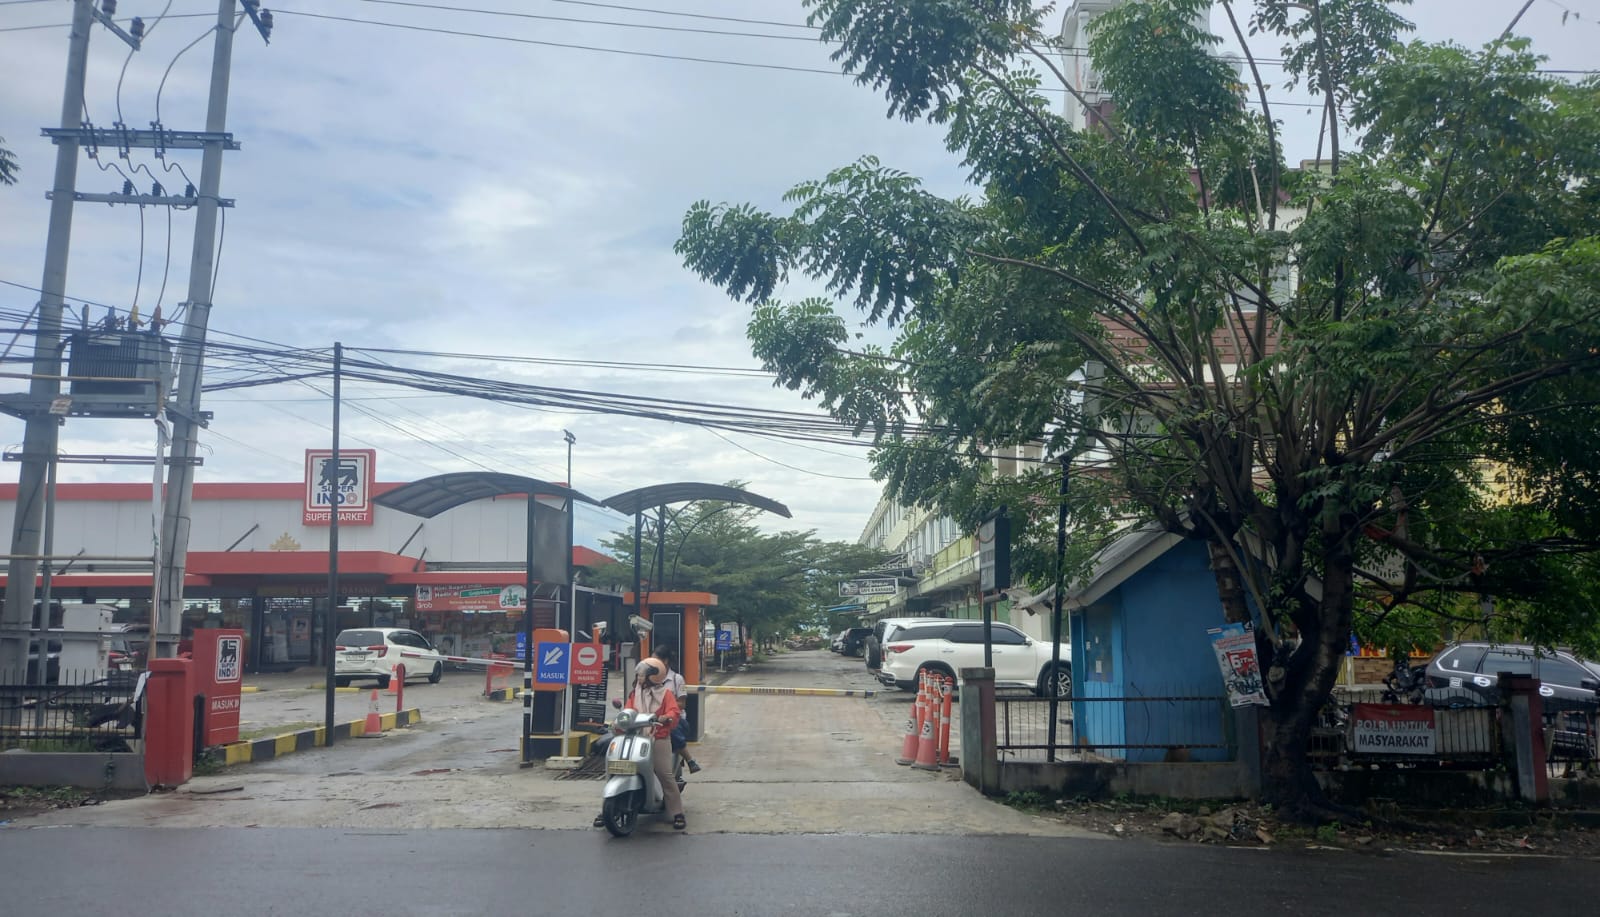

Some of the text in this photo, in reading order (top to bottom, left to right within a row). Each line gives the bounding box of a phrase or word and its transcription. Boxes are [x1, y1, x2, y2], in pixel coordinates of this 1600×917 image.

[540, 672, 565, 680] MASUK
[1357, 720, 1430, 731] POLRI UNTUK
[1359, 734, 1430, 748] MASYARAKAT
